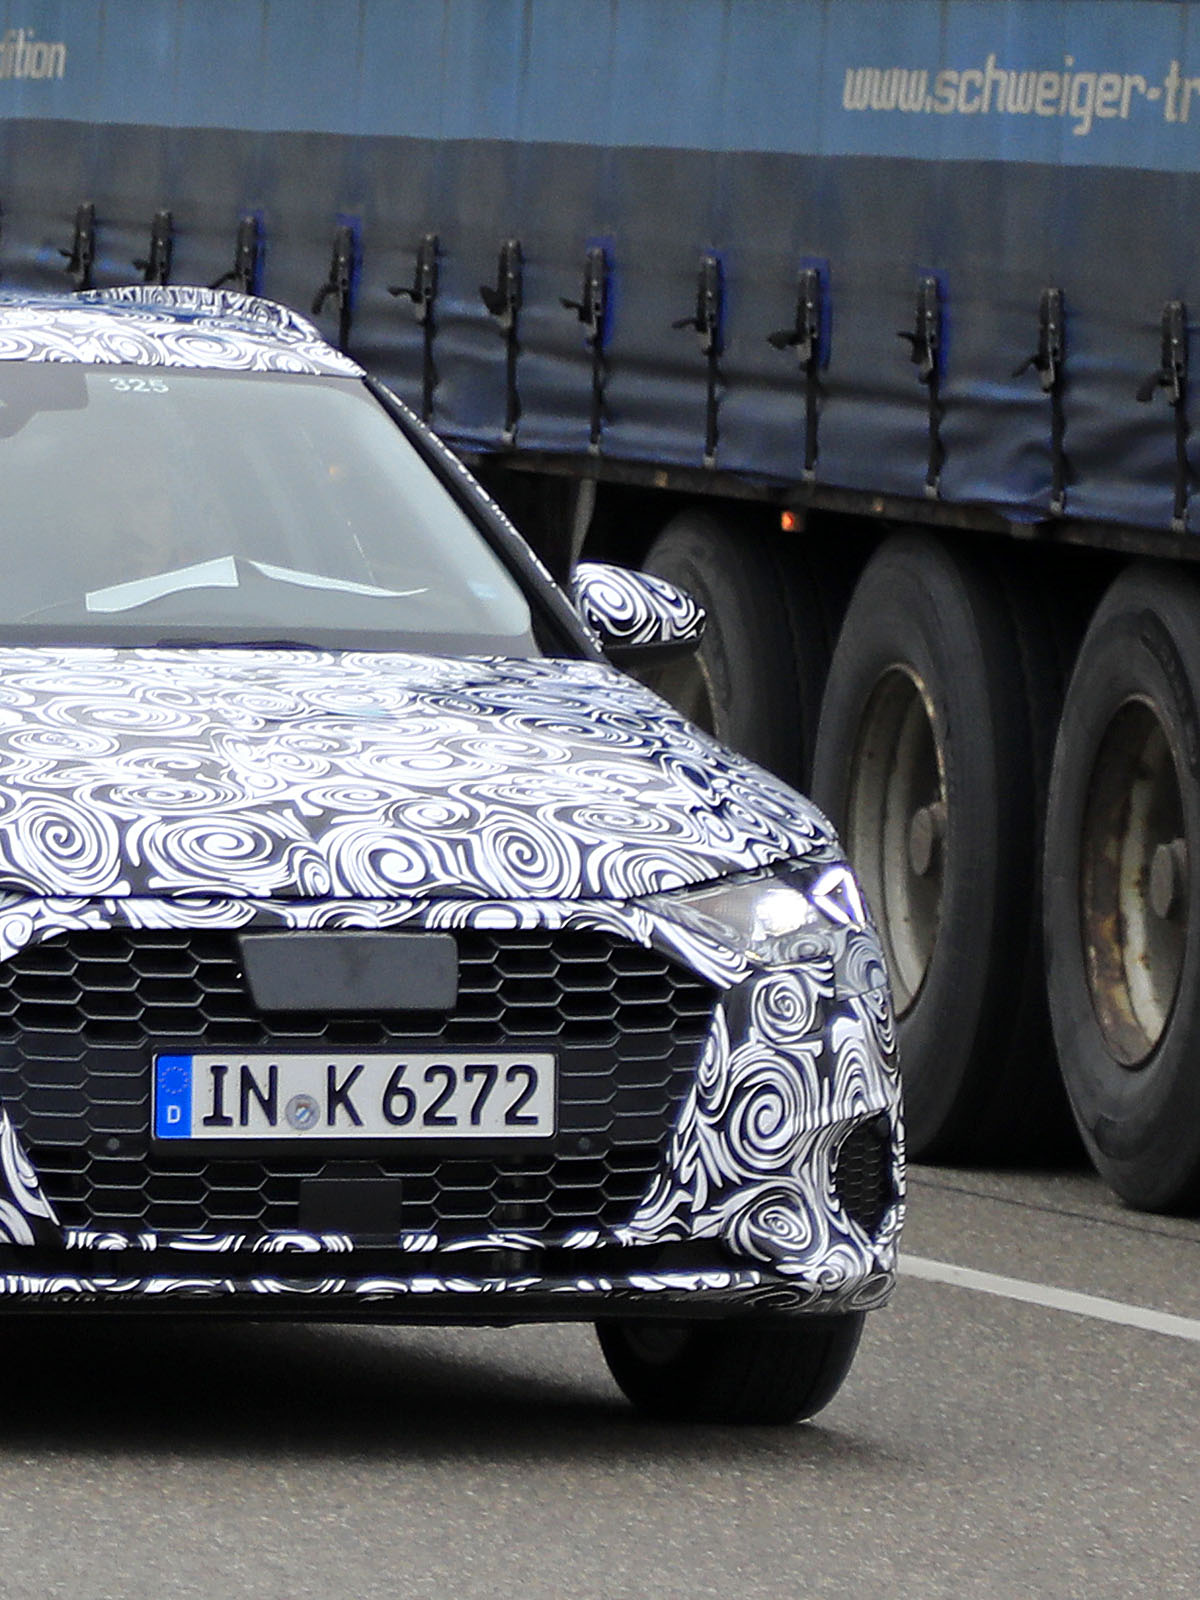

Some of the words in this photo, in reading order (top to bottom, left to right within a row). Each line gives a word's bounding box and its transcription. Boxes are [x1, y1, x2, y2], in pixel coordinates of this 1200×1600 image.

[166, 1106, 182, 1124] D
[203, 1065, 278, 1127] IN
[327, 1065, 365, 1127] K
[382, 1065, 540, 1127] 6272
